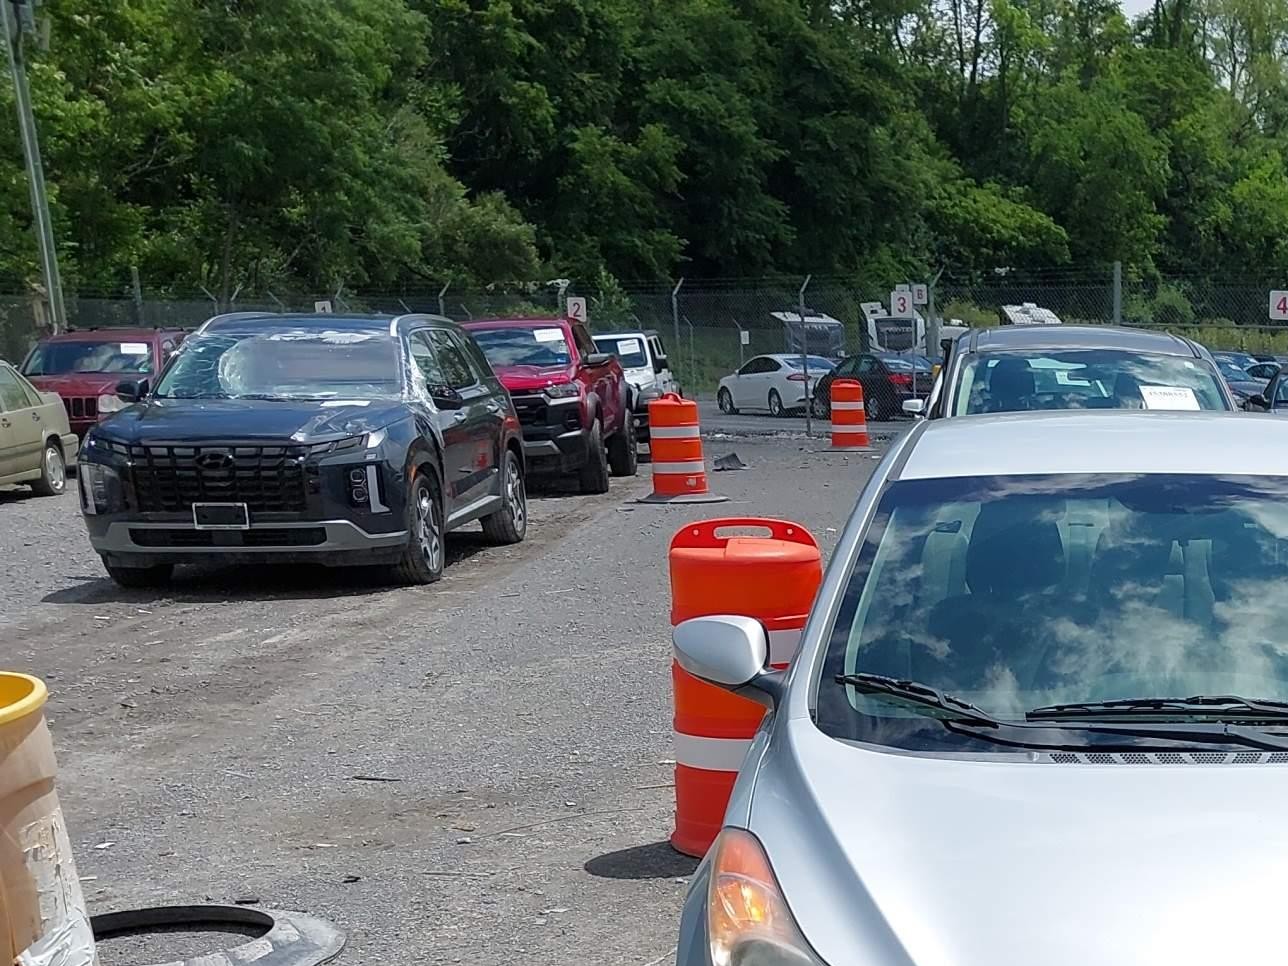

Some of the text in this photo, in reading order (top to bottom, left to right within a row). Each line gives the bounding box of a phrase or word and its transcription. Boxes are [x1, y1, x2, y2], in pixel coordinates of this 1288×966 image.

[572, 302, 582, 317] 2
[897, 296, 906, 313] 3
[1276, 296, 1288, 315] 4
